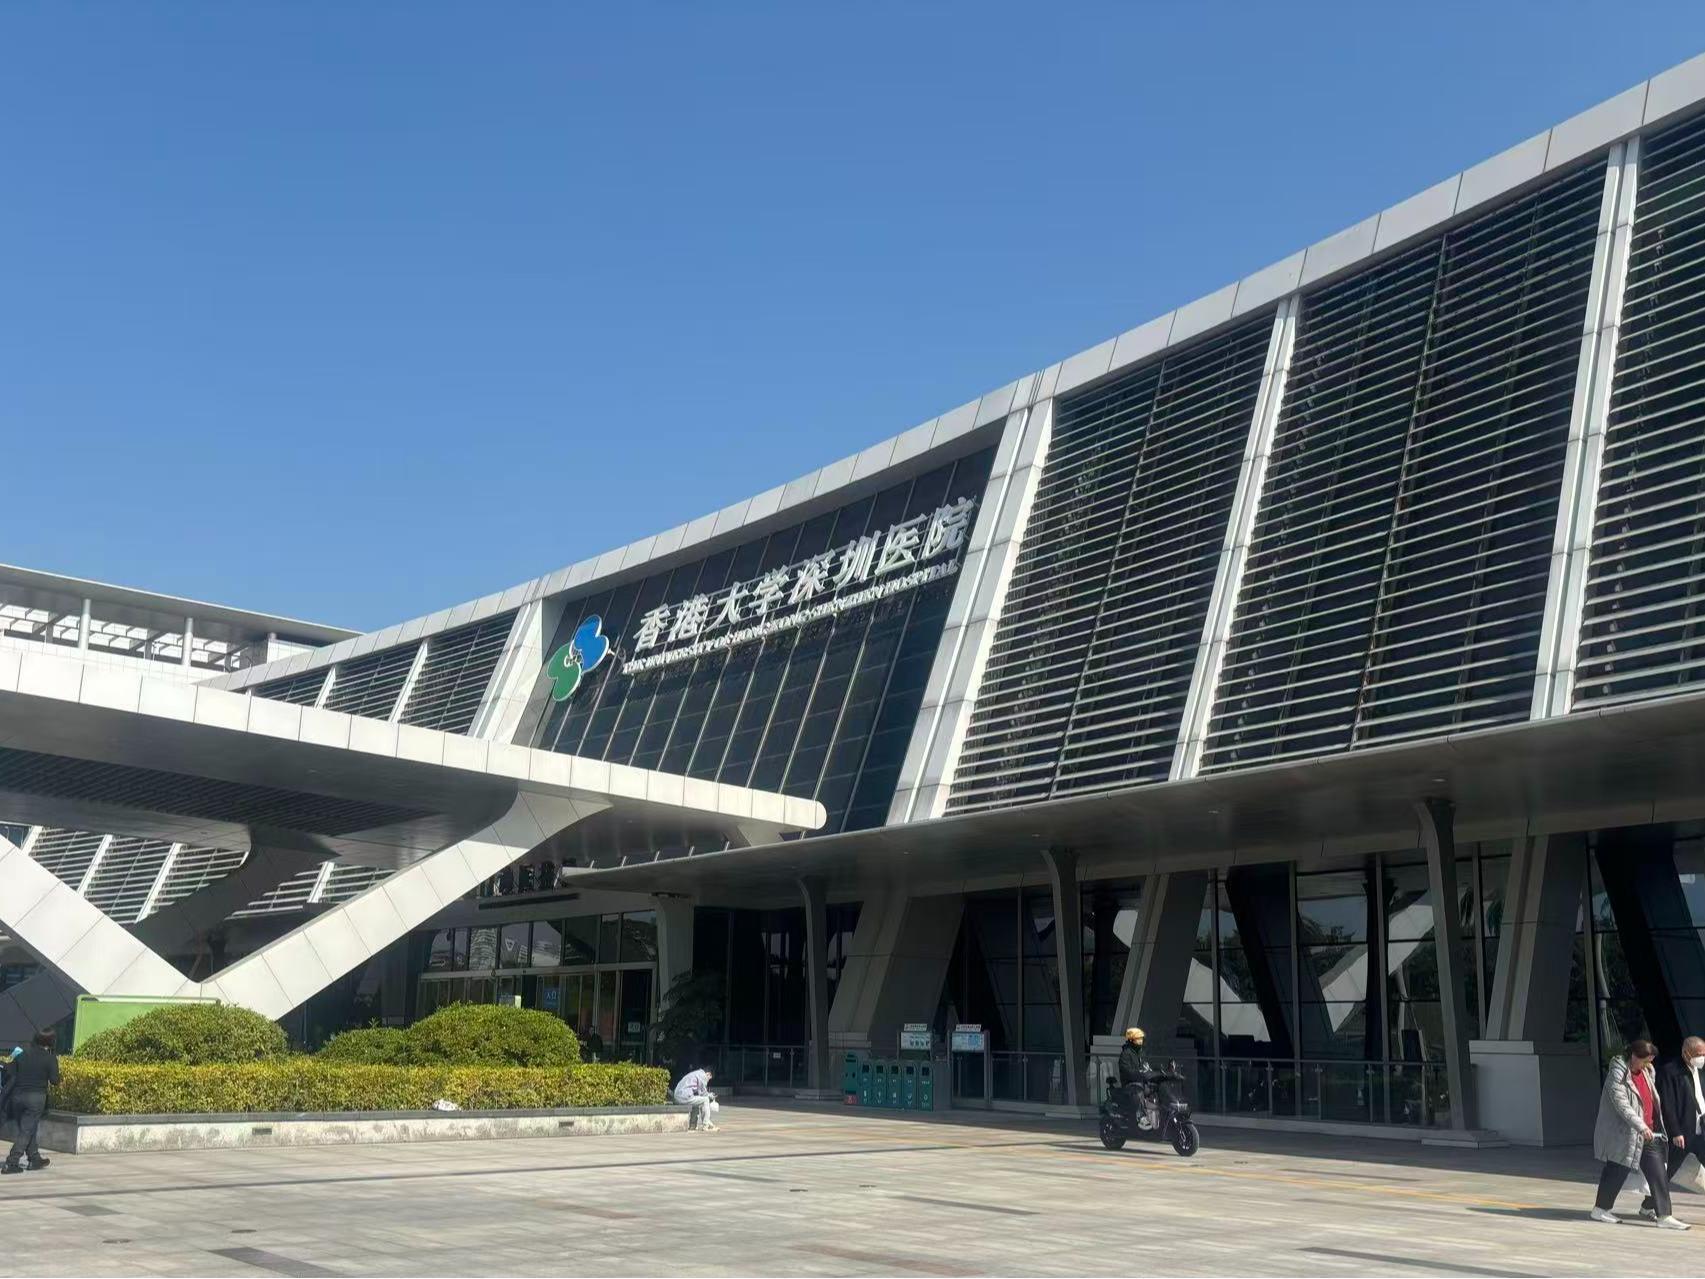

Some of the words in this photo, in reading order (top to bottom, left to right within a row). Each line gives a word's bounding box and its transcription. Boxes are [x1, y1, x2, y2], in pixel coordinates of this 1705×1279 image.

[633, 497, 974, 651] 香港大学深圳医院
